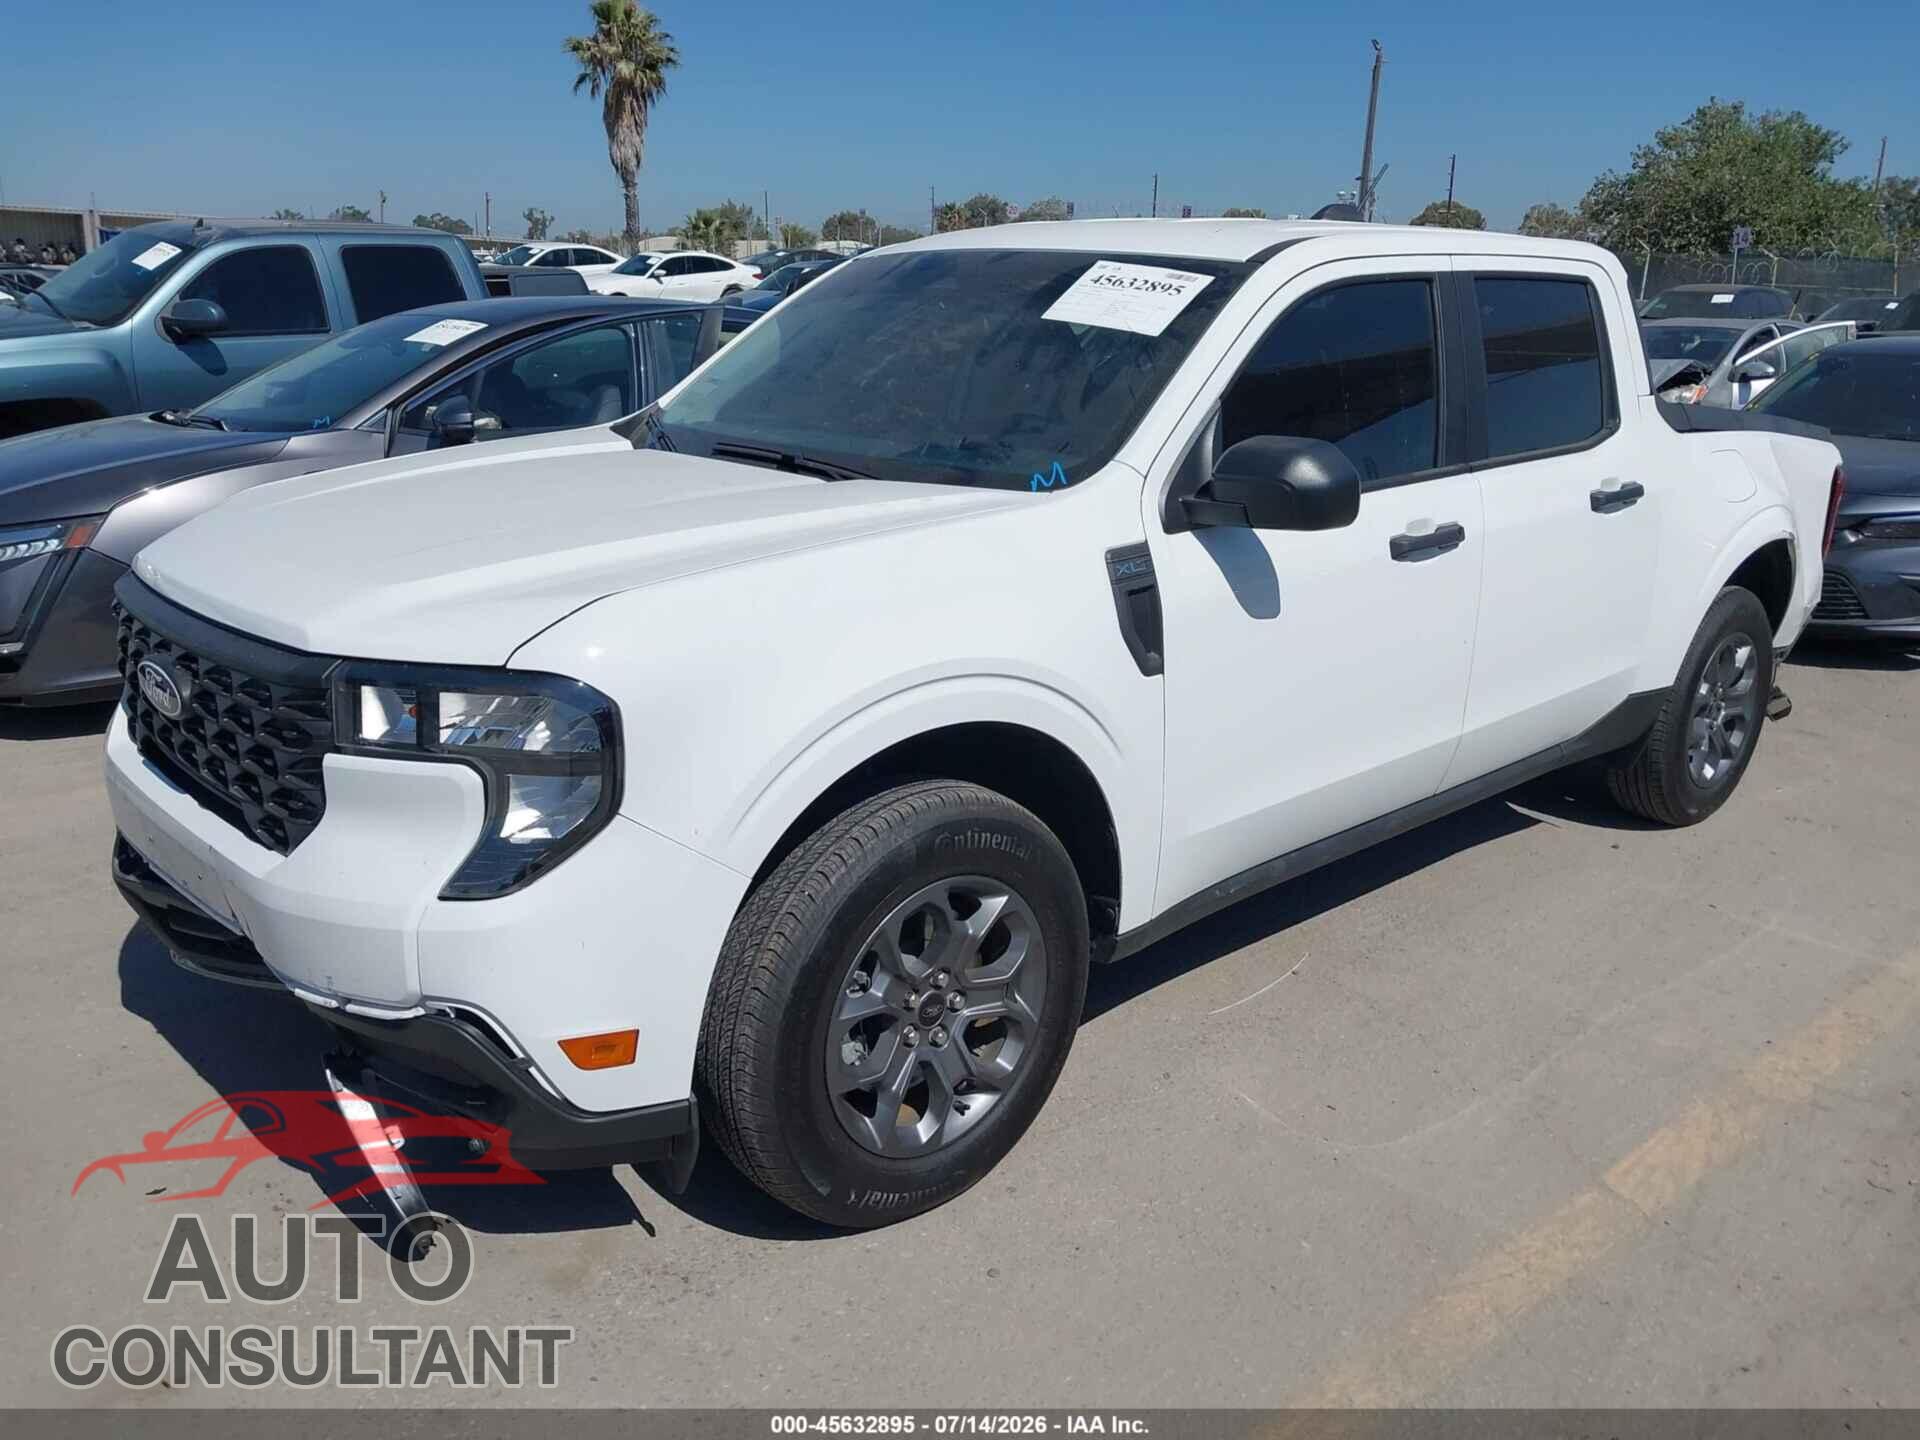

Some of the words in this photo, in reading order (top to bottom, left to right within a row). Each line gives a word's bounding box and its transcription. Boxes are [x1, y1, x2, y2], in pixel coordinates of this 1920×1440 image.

[1090, 273, 1186, 296] 45632895
[1030, 461, 1067, 494] M
[143, 668, 170, 707] Ford
